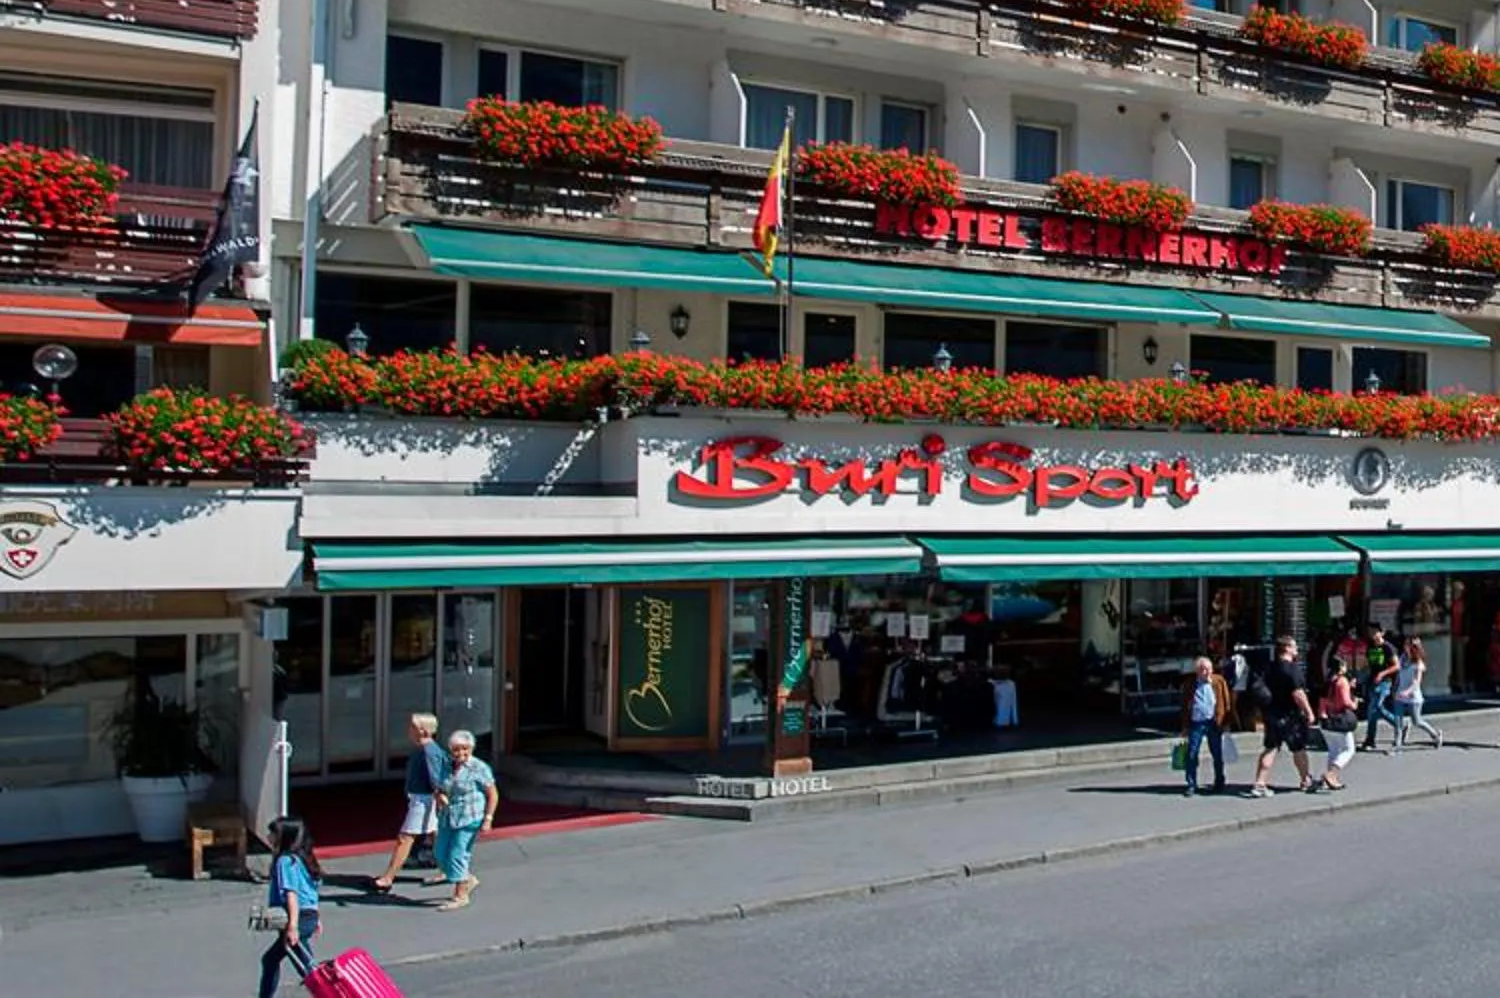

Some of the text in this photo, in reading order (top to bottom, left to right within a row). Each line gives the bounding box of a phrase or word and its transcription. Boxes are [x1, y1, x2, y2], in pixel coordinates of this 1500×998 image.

[875, 205, 1287, 274] HOTEL BERNERHOF
[676, 434, 1199, 507] Buri Sport
[660, 601, 673, 650] HOTEL
[784, 577, 803, 682] Bernerho
[624, 595, 673, 730] Bernerhof
[771, 776, 834, 796] HOTEL
